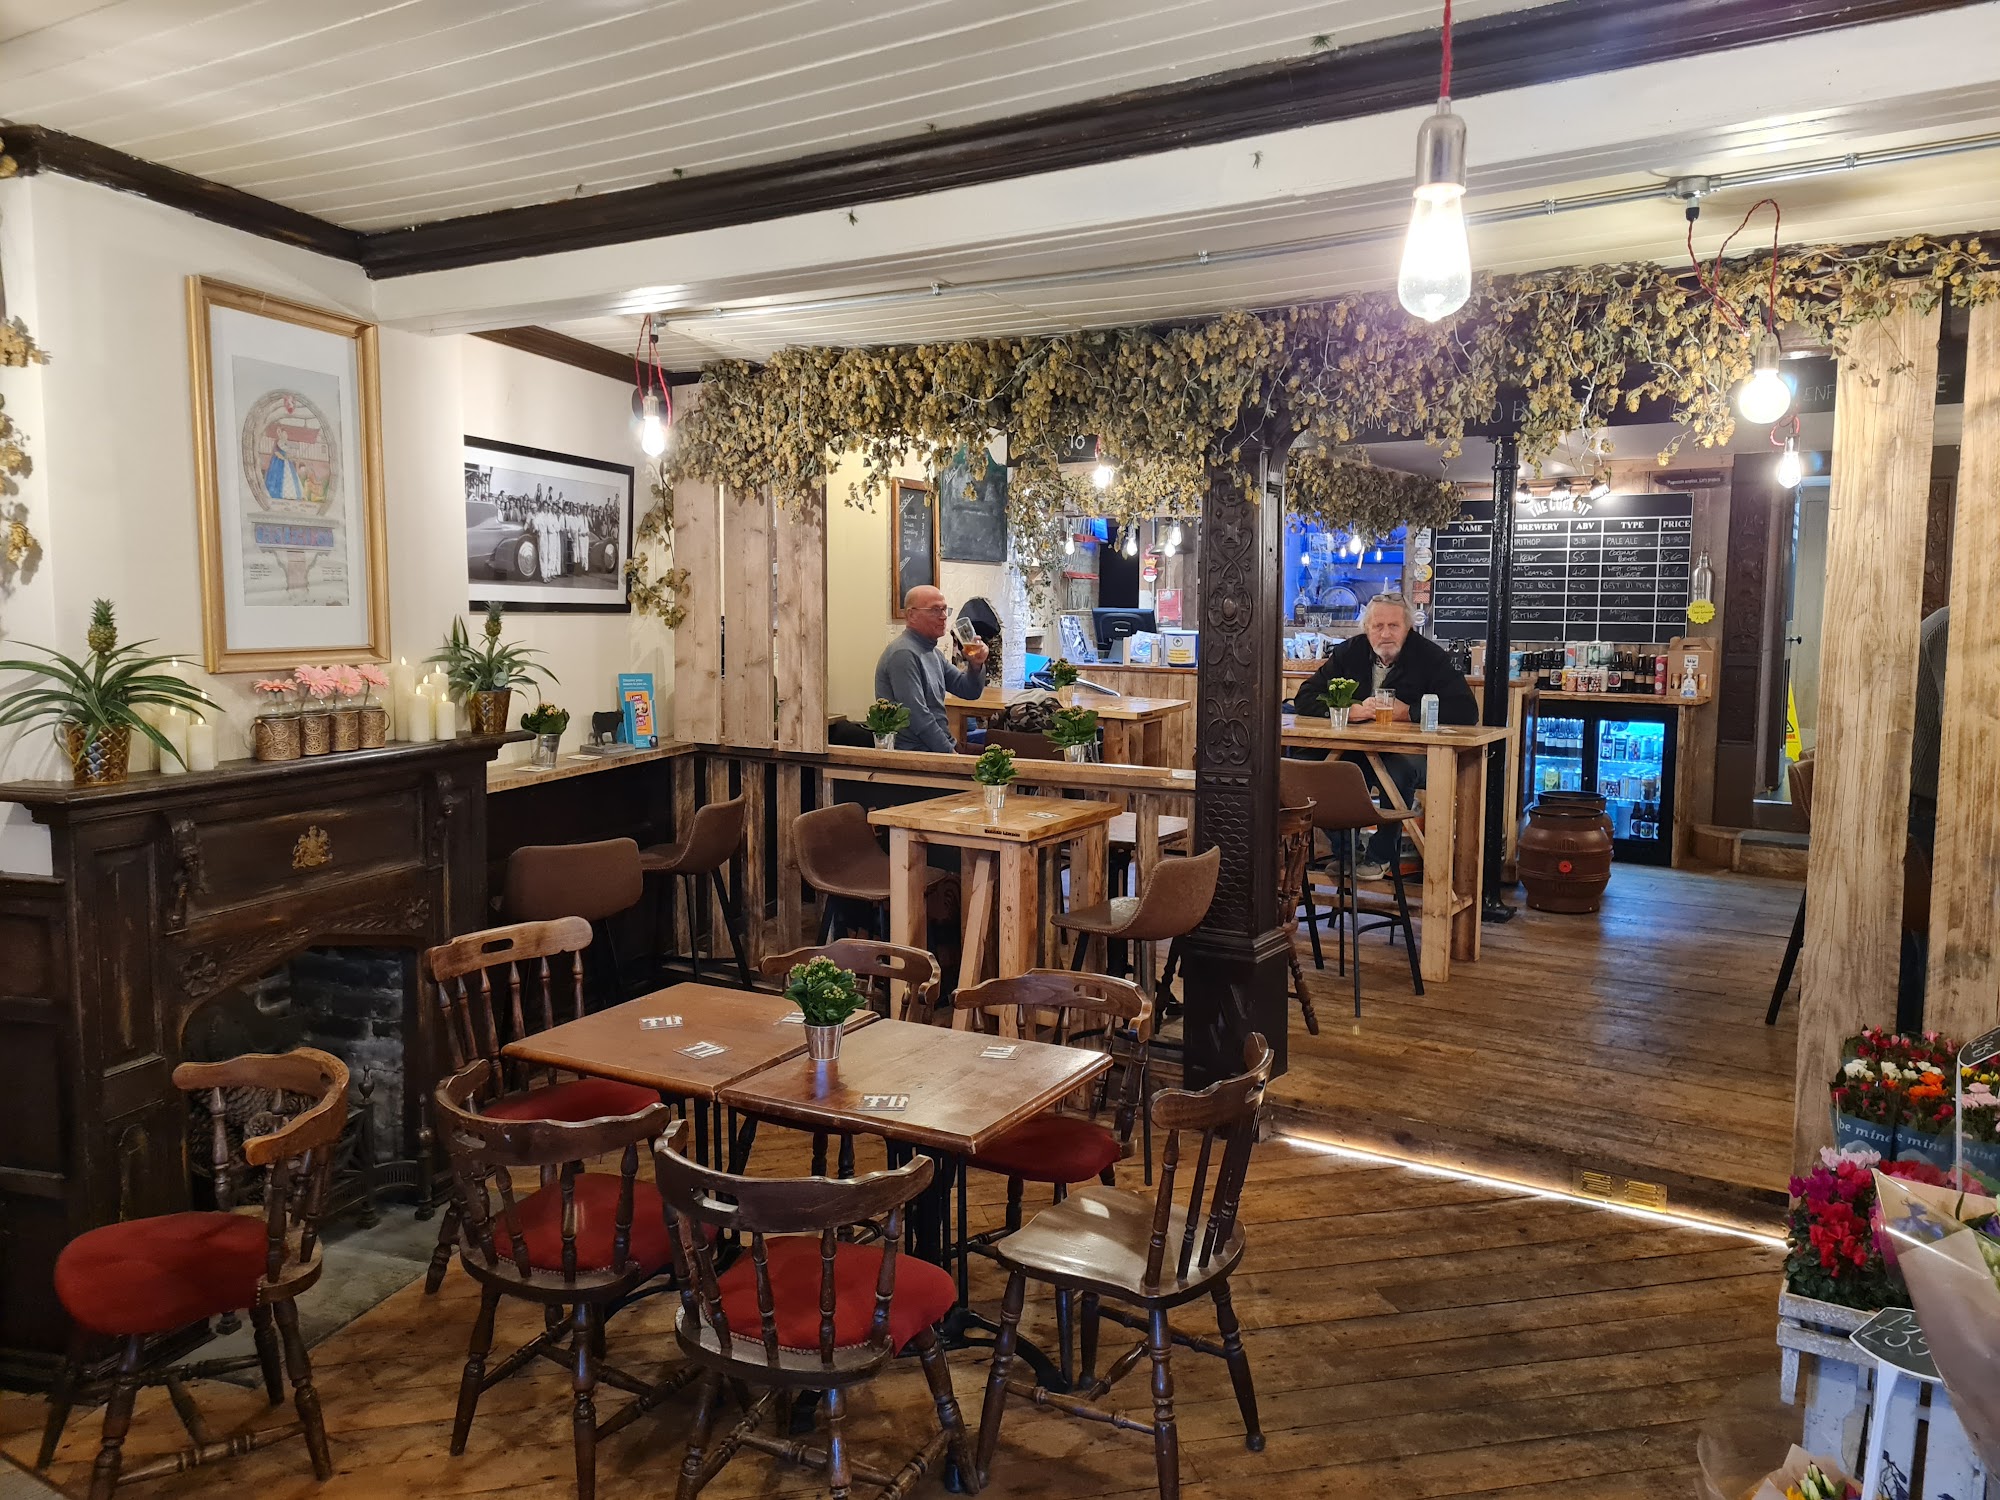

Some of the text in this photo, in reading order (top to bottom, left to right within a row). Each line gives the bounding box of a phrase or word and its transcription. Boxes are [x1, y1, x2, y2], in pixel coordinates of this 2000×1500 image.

[1528, 500, 1549, 518] THE
[1458, 520, 1691, 533] NAME BREWERY ABV TYPE PRICE
[1452, 538, 1467, 548] PIT
